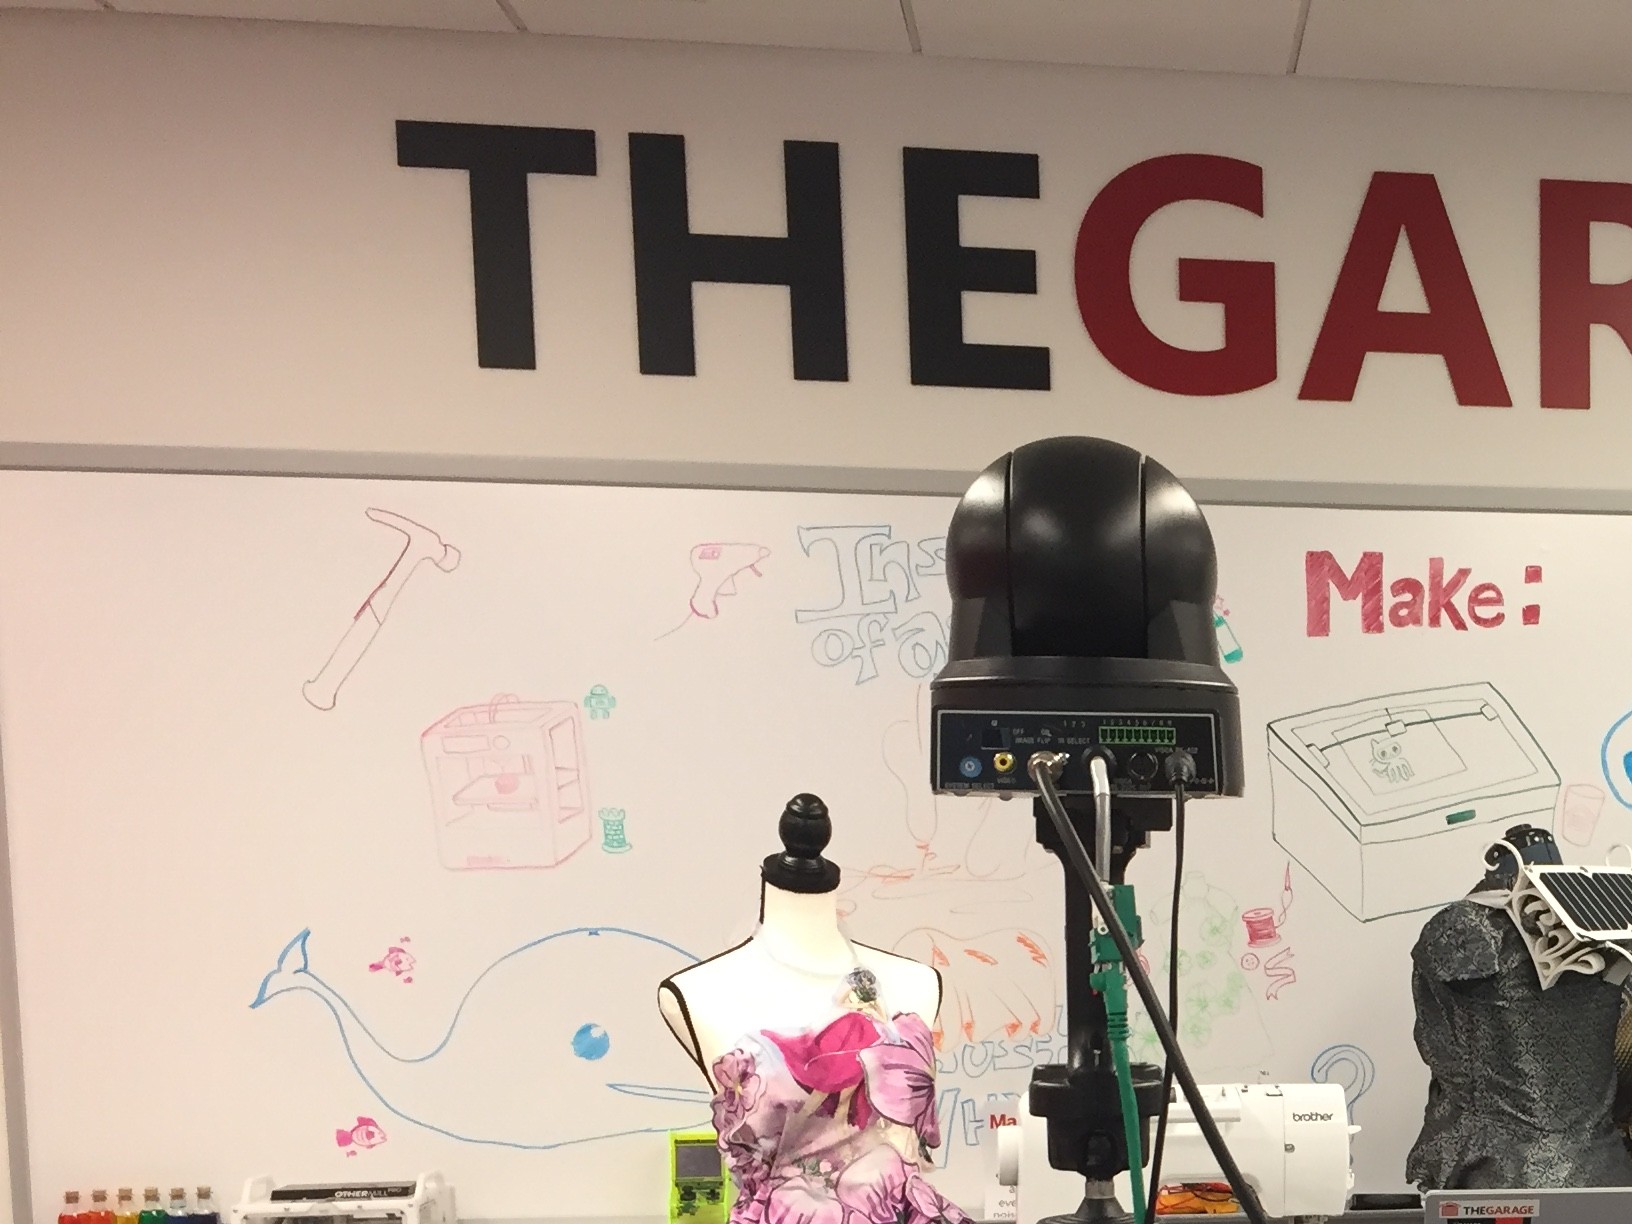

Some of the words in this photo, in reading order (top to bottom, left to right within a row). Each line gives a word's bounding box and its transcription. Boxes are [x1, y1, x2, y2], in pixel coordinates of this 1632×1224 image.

[1304, 550, 1544, 637] Make:
[1292, 1111, 1334, 1122] brother
[1463, 1205, 1535, 1215] THEGARAGE
